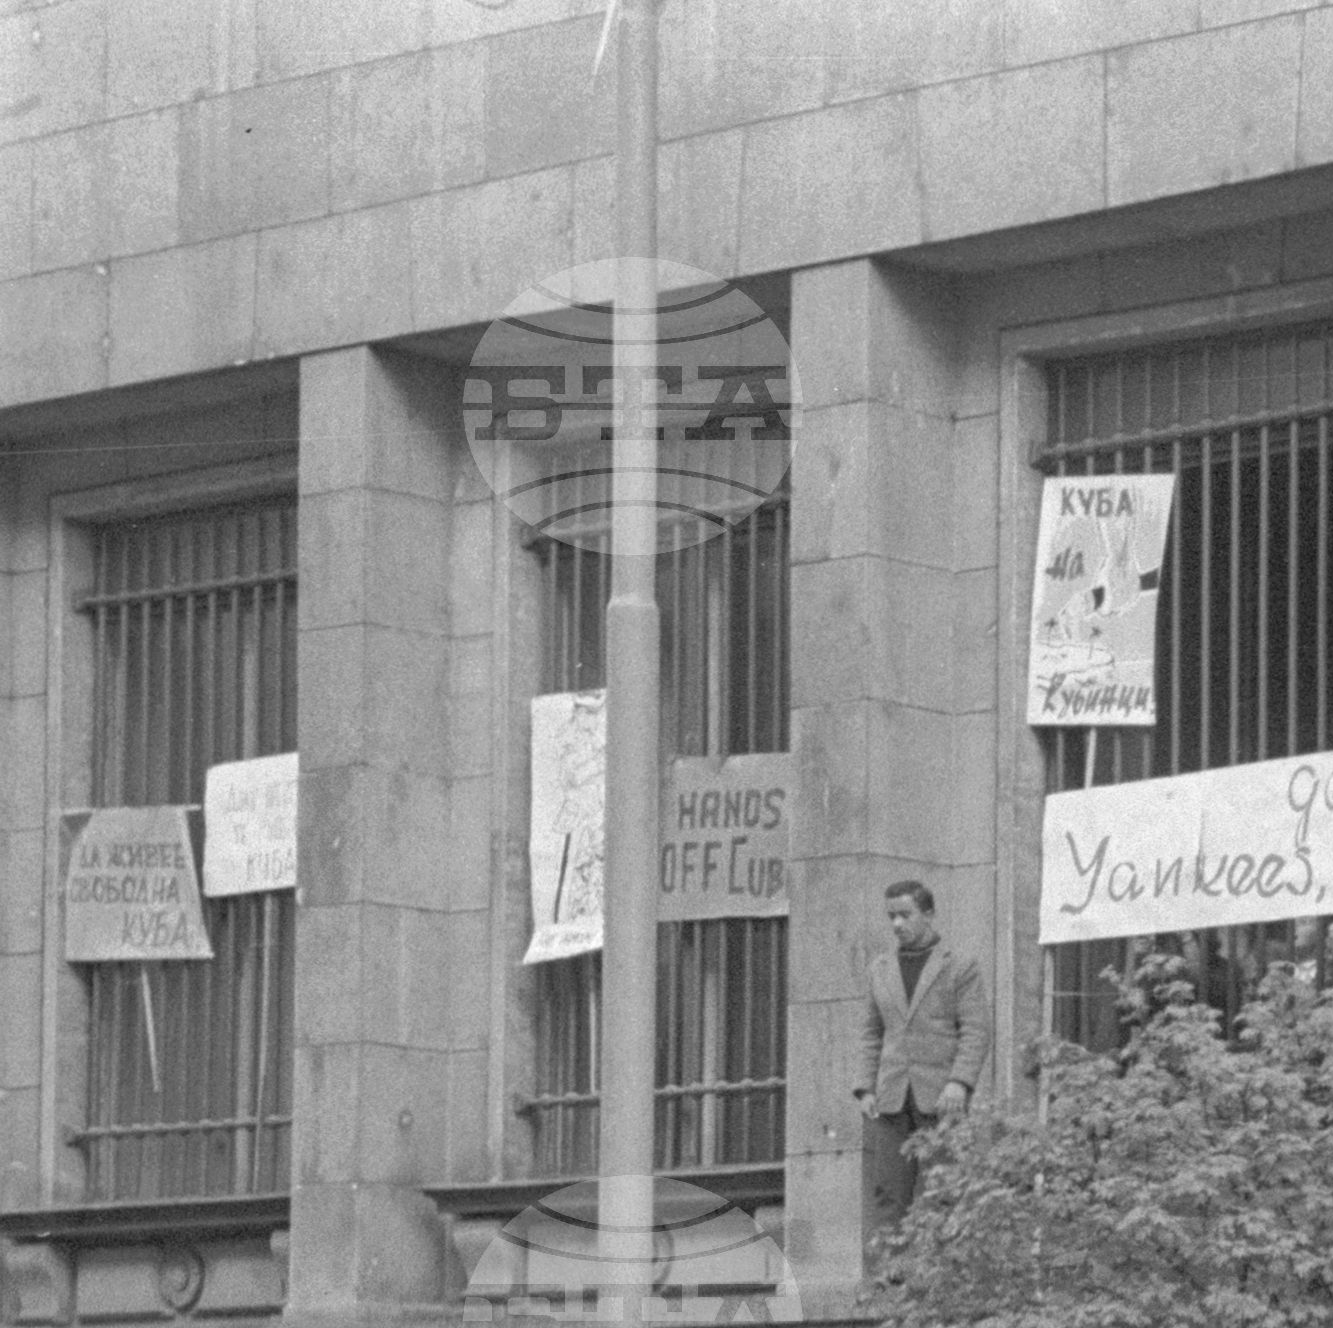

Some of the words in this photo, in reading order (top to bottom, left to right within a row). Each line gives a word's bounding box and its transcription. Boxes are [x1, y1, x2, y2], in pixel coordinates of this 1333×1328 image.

[1060, 487, 1134, 518] КУБА
[679, 787, 786, 830] HANDS
[107, 842, 186, 870] ЖИВЕЕ
[660, 840, 723, 894] OFF
[728, 835, 785, 899] CUB
[1060, 831, 1327, 914] Yankees,
[71, 874, 181, 904] СВОБОДНА
[121, 911, 189, 947] КУБА
